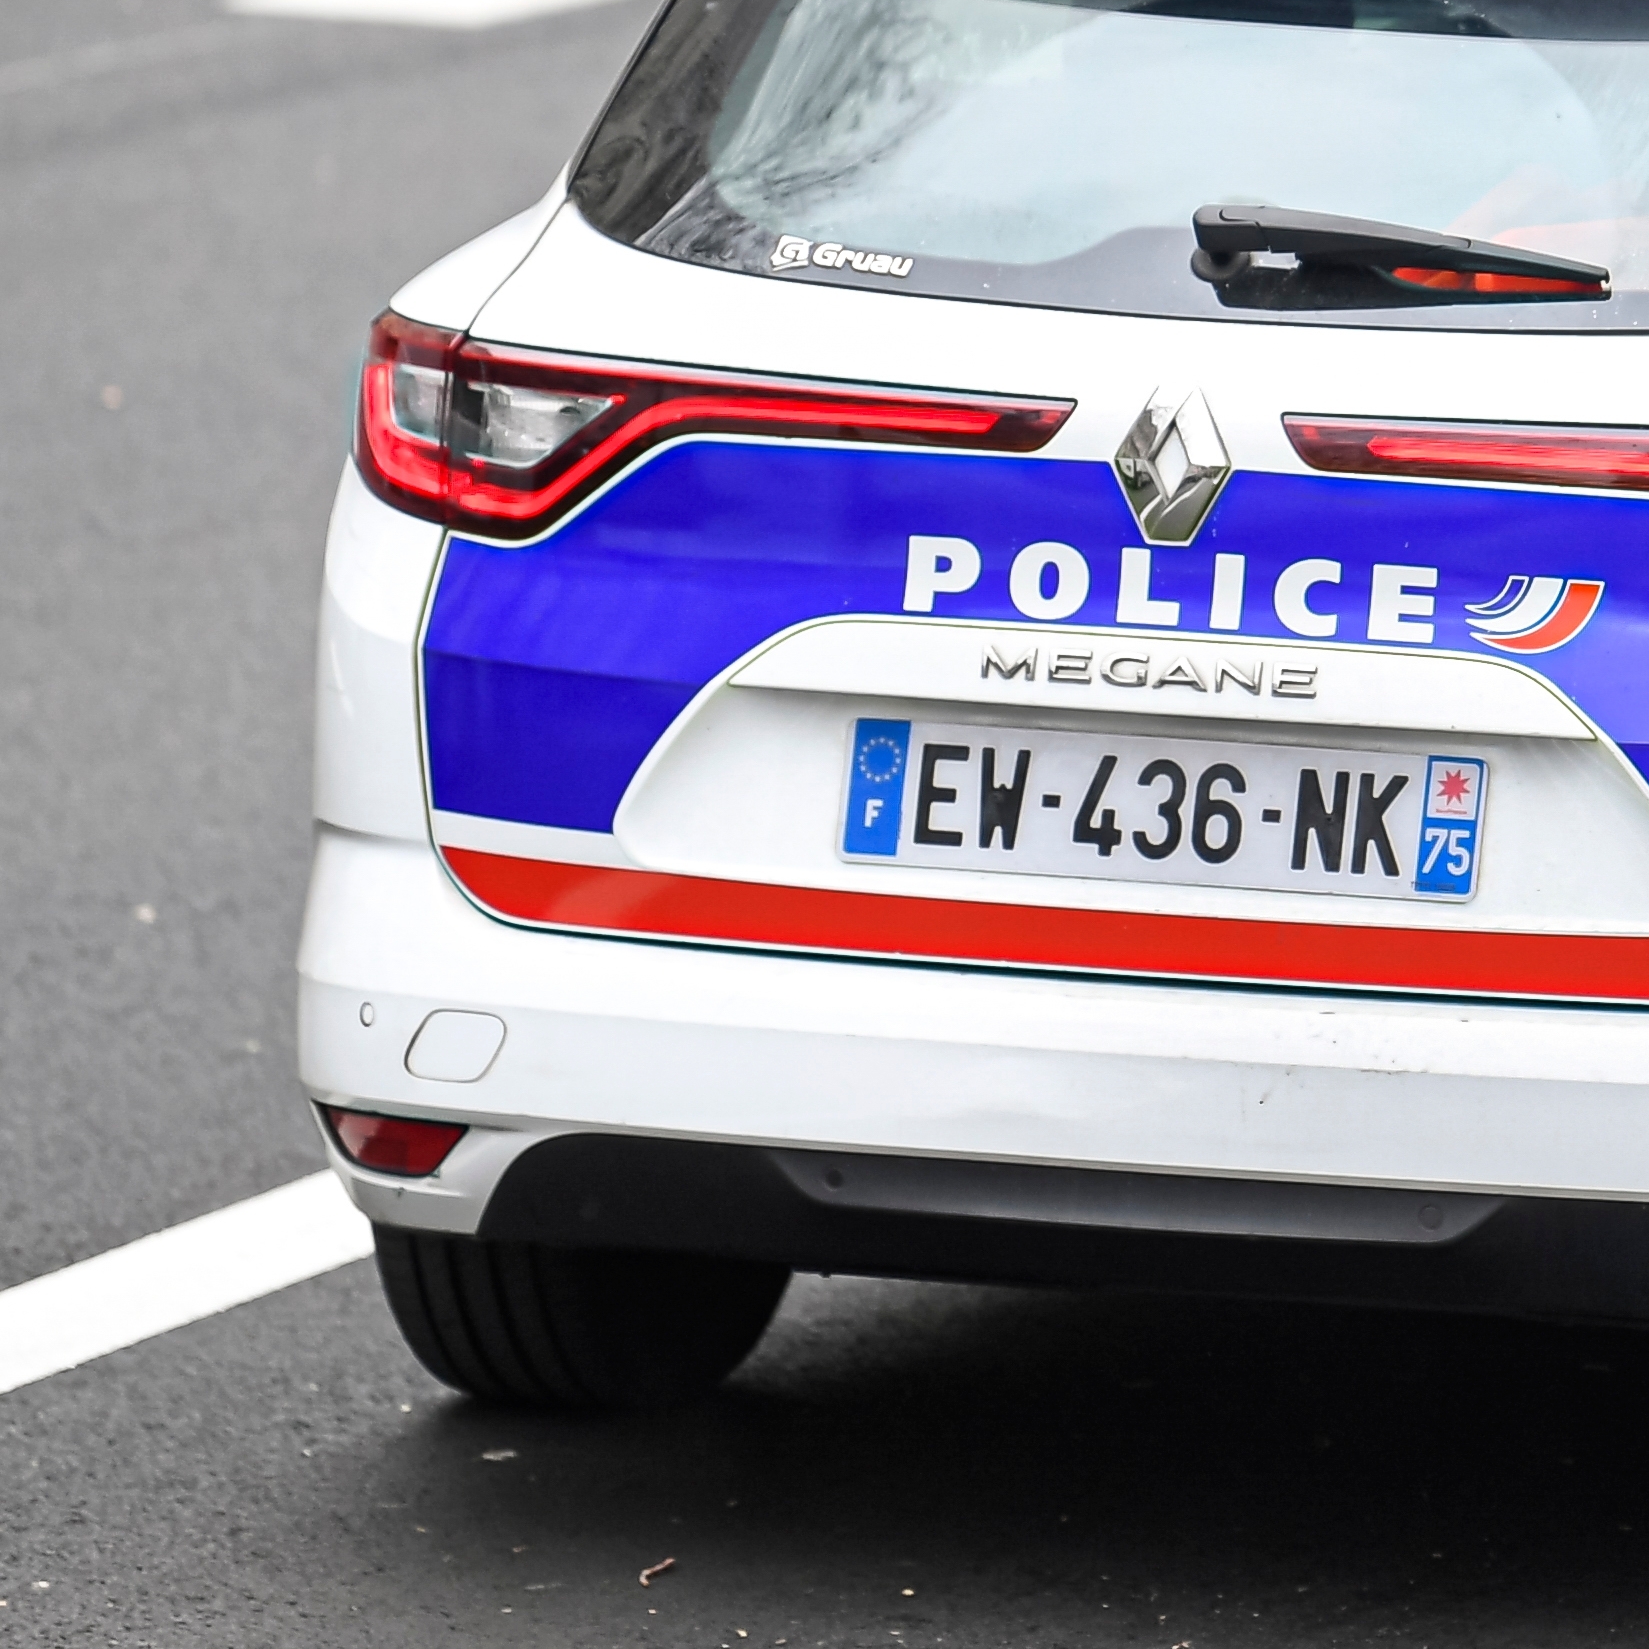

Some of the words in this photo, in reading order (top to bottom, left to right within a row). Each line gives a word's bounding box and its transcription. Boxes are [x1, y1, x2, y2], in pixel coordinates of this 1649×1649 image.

[812, 242, 914, 277] Gruau
[902, 534, 1438, 644] POLICE
[979, 642, 1320, 699] MEGANE
[862, 799, 884, 828] F
[913, 742, 1411, 878] EW-436-NK
[1422, 827, 1471, 876] 75
